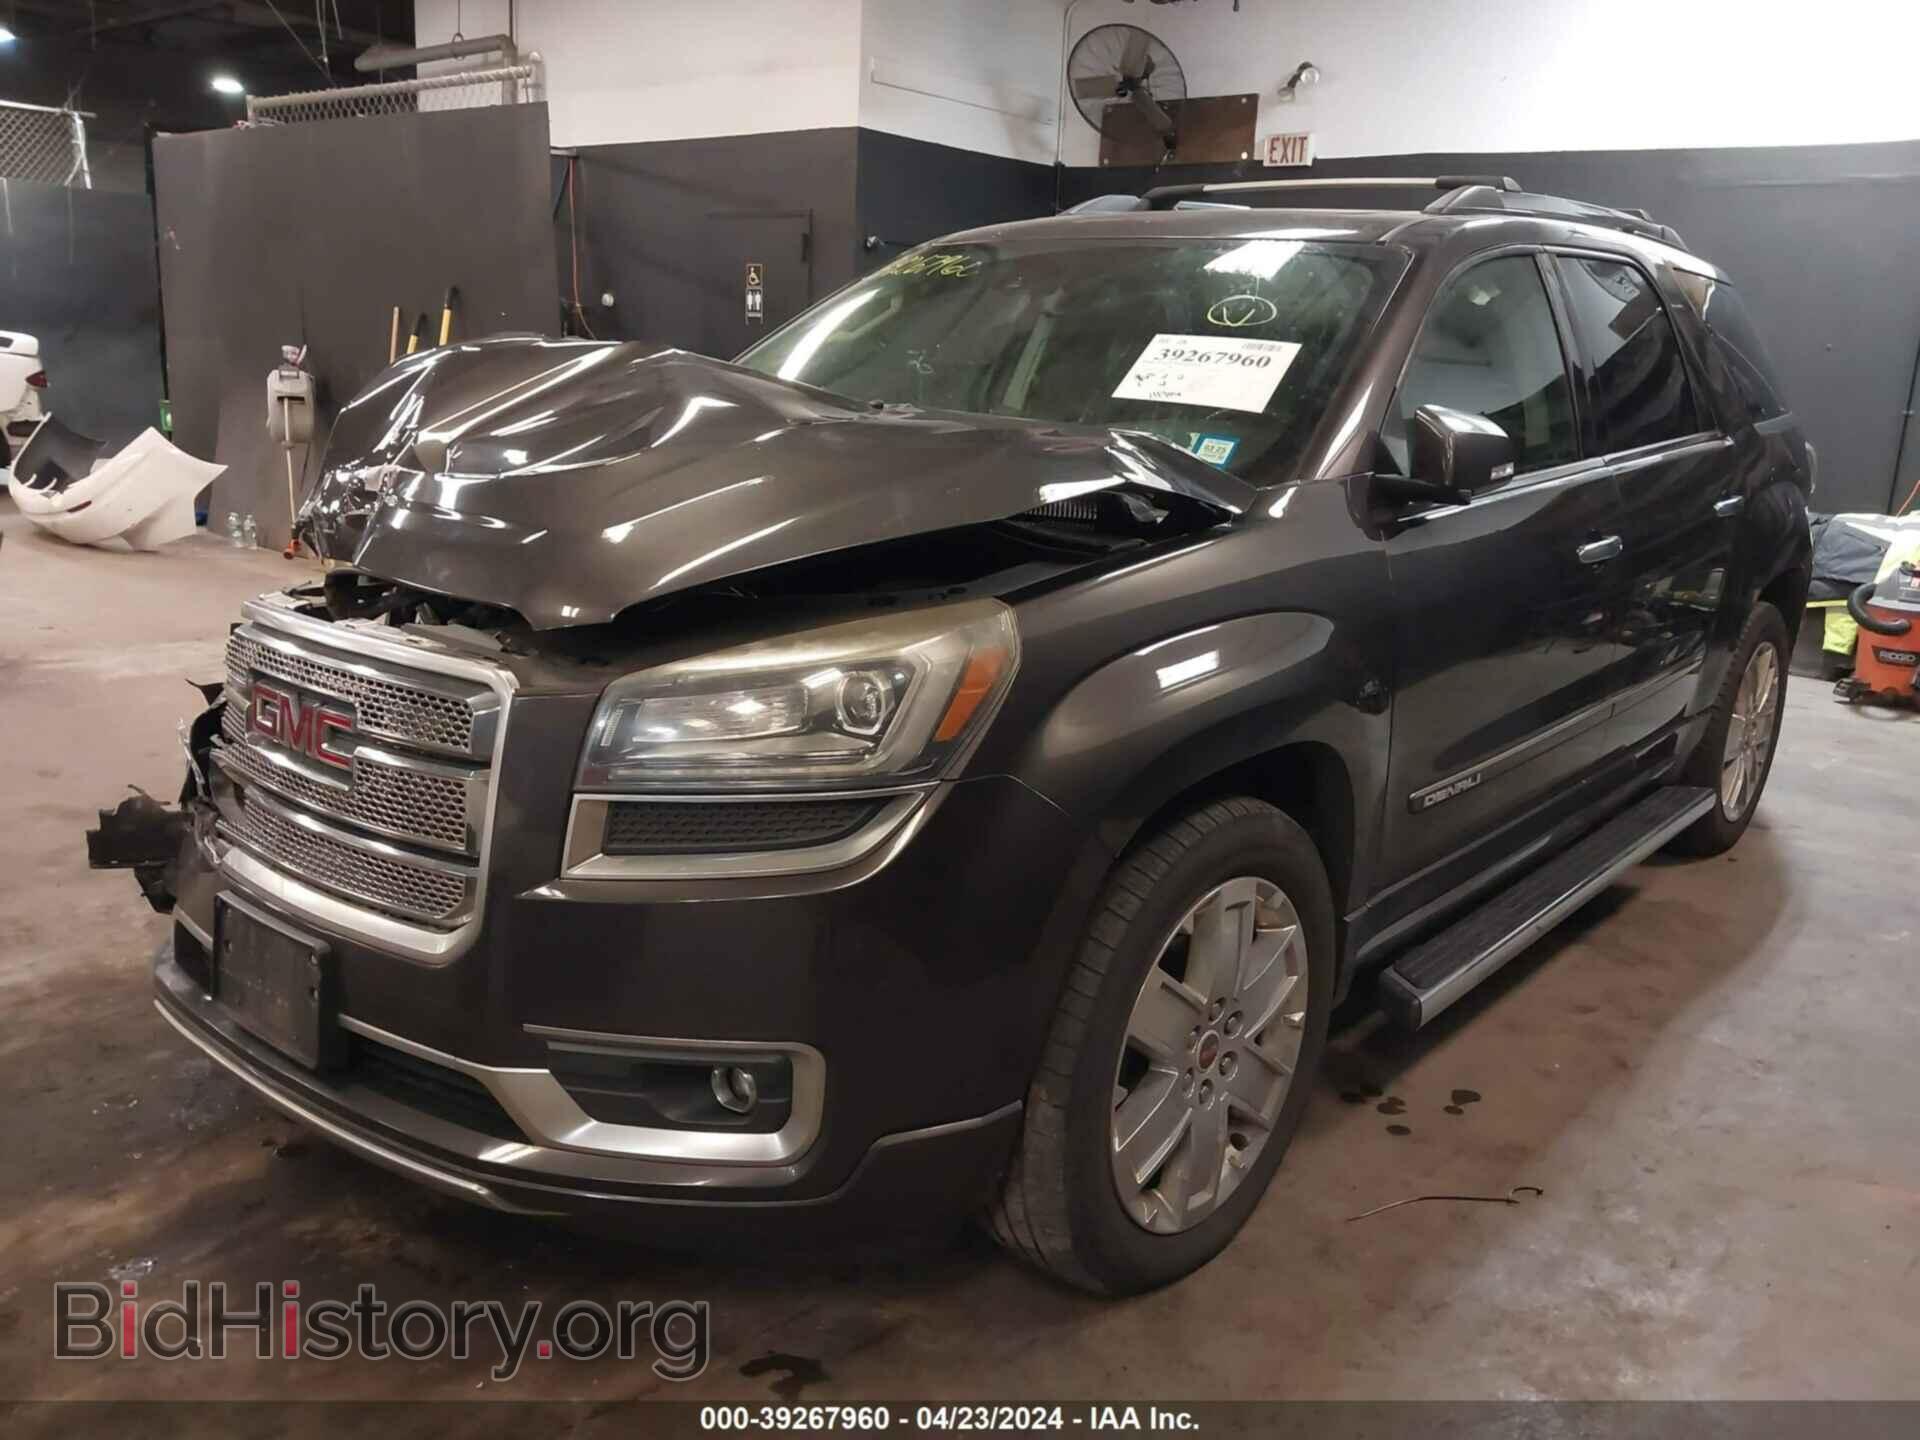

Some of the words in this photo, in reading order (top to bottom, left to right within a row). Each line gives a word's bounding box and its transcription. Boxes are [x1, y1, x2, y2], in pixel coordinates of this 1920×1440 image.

[1269, 136, 1307, 163] EXIT
[1153, 348, 1272, 369] 39267960
[251, 681, 352, 770] GMC
[1423, 772, 1481, 808] DENALI
